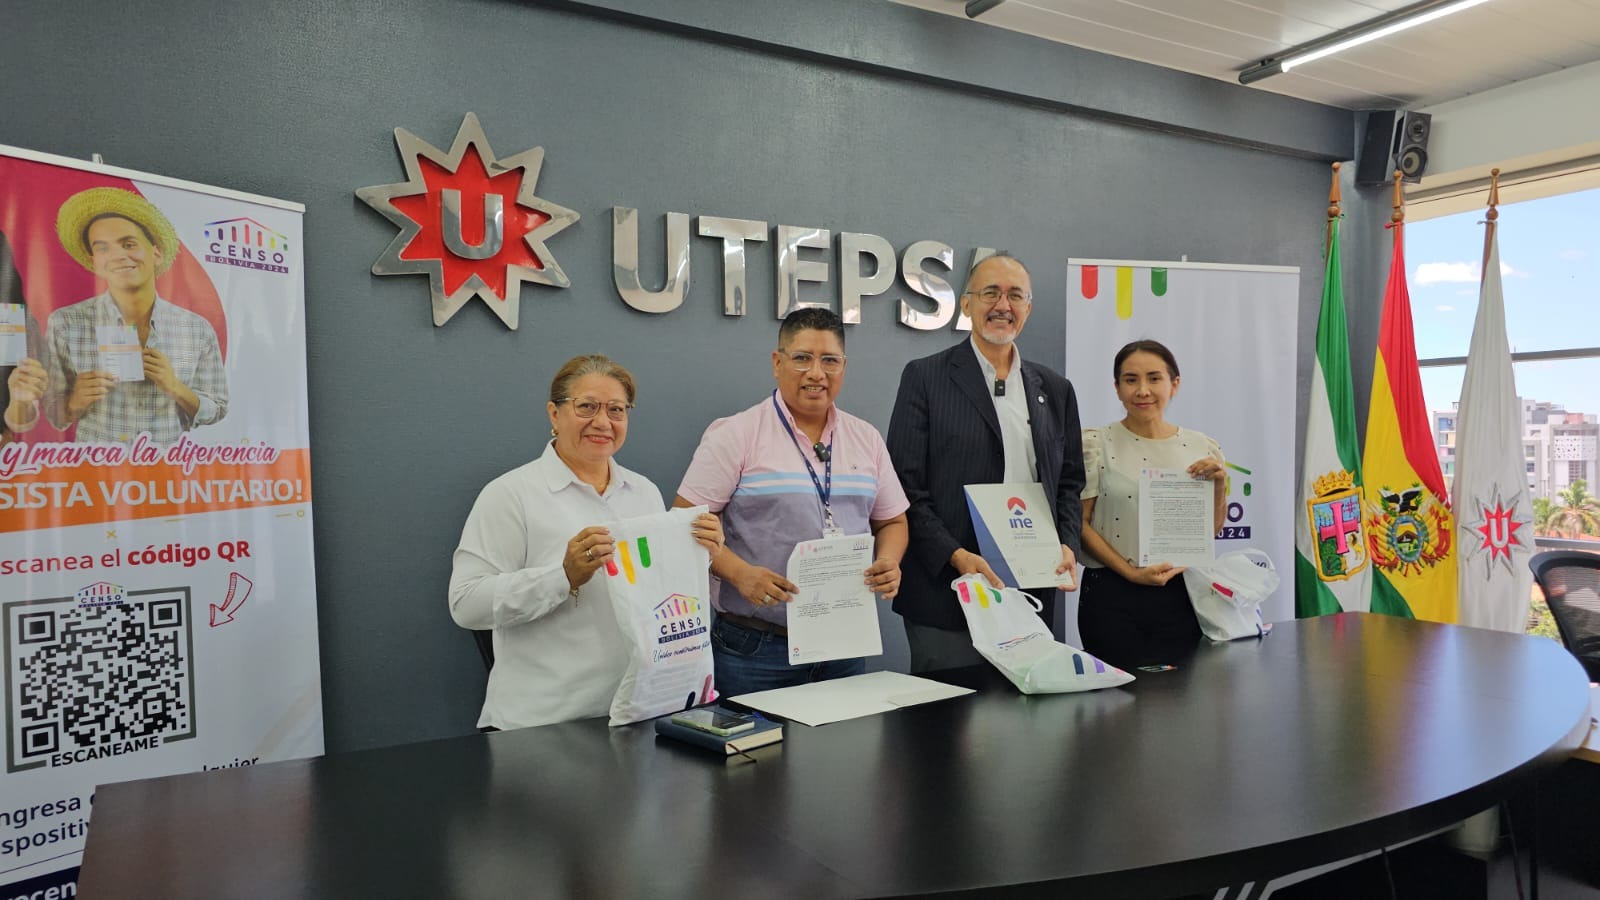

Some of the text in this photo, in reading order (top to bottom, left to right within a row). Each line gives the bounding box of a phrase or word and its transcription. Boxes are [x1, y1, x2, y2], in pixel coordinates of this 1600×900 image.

[441, 187, 504, 260] U
[209, 242, 285, 264] CENSO
[209, 255, 286, 273] BOLIVIA 2024
[30, 446, 123, 465] marca
[131, 435, 159, 463] la
[167, 435, 276, 473] diferencia
[98, 479, 303, 506] VOLUNTARIO!
[1008, 517, 1033, 529] ine
[1490, 517, 1509, 548] U
[0, 541, 251, 575] scanea el código QR
[81, 594, 122, 604] CENSO
[660, 616, 702, 635] CENSO
[51, 735, 160, 768] ESCANEAME
